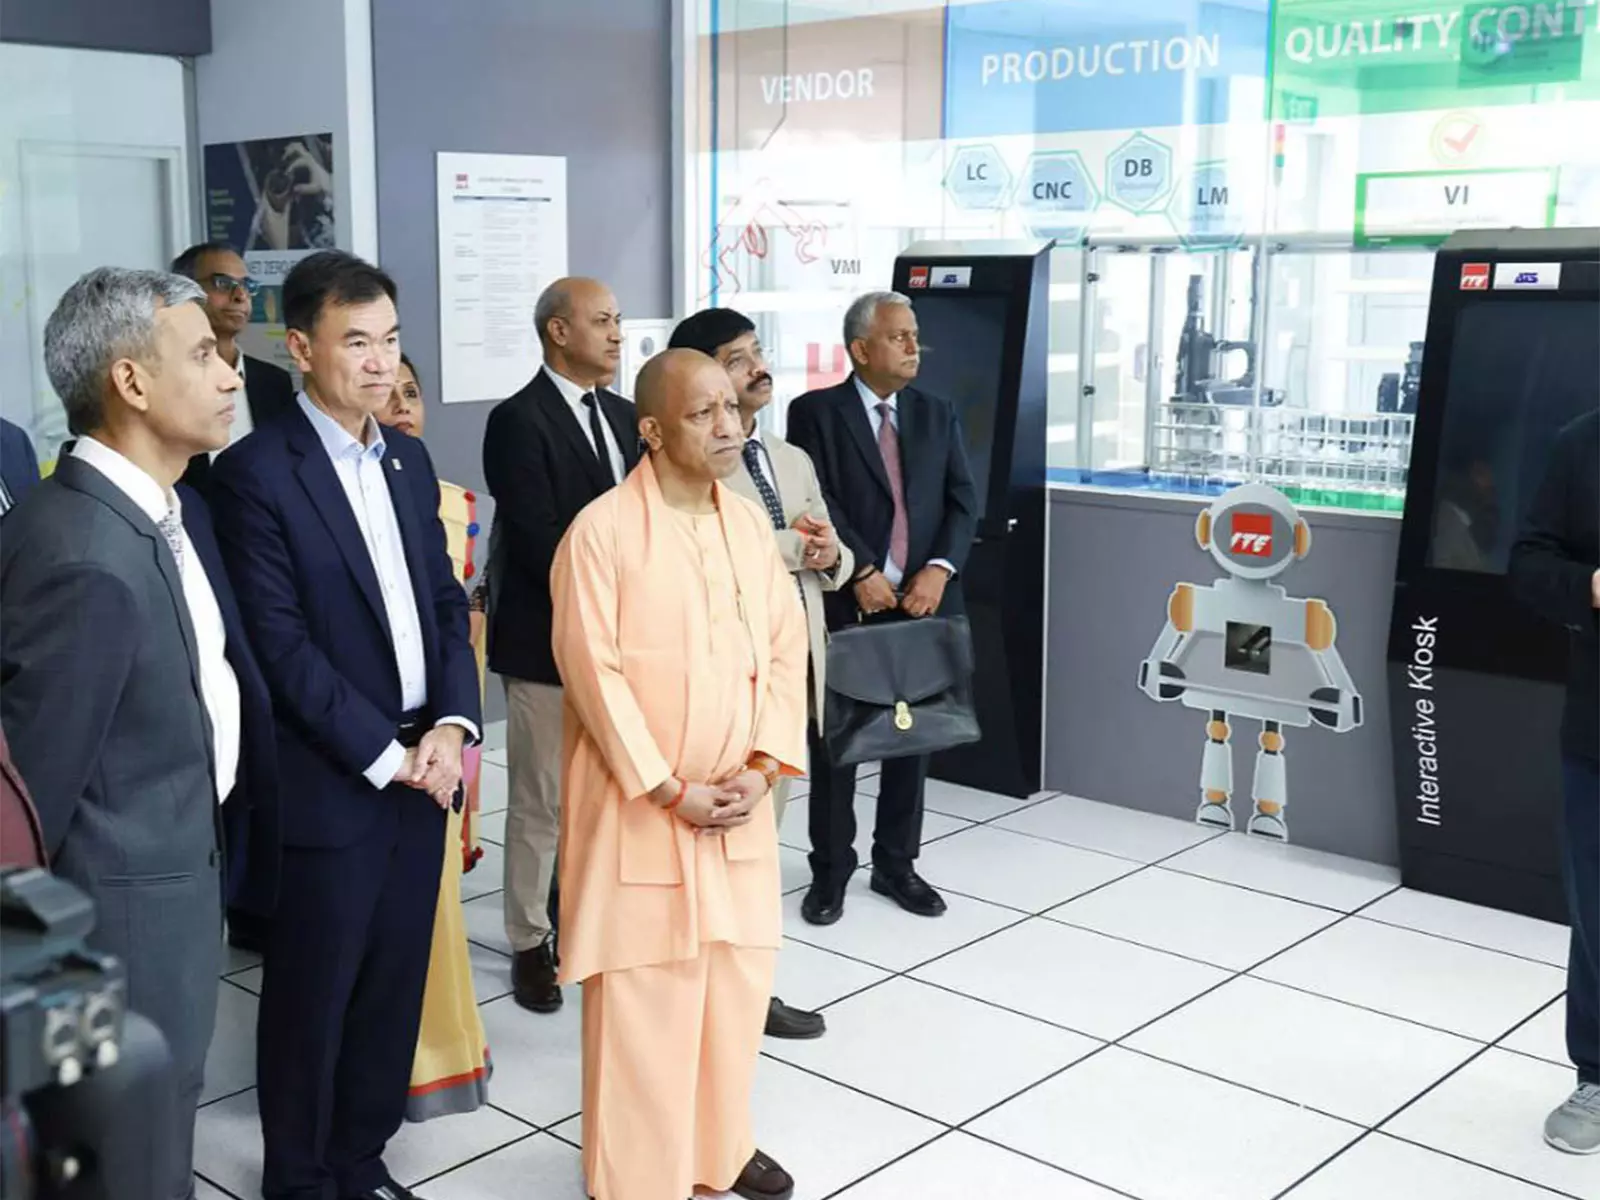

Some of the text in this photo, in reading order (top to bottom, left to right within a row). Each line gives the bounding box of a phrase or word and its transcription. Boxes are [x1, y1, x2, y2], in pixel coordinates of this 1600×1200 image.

[1285, 0, 1600, 63] QUALITY CONT
[981, 33, 1221, 86] PRODUCTION
[760, 68, 875, 105] VENDOR
[966, 163, 988, 181] LC
[1124, 158, 1153, 178] DB
[1032, 181, 1073, 200] CNC
[1197, 186, 1229, 206] LM
[1444, 185, 1469, 205] VI
[831, 260, 861, 275] VMI
[1408, 615, 1442, 826] Interactive Kiosk
